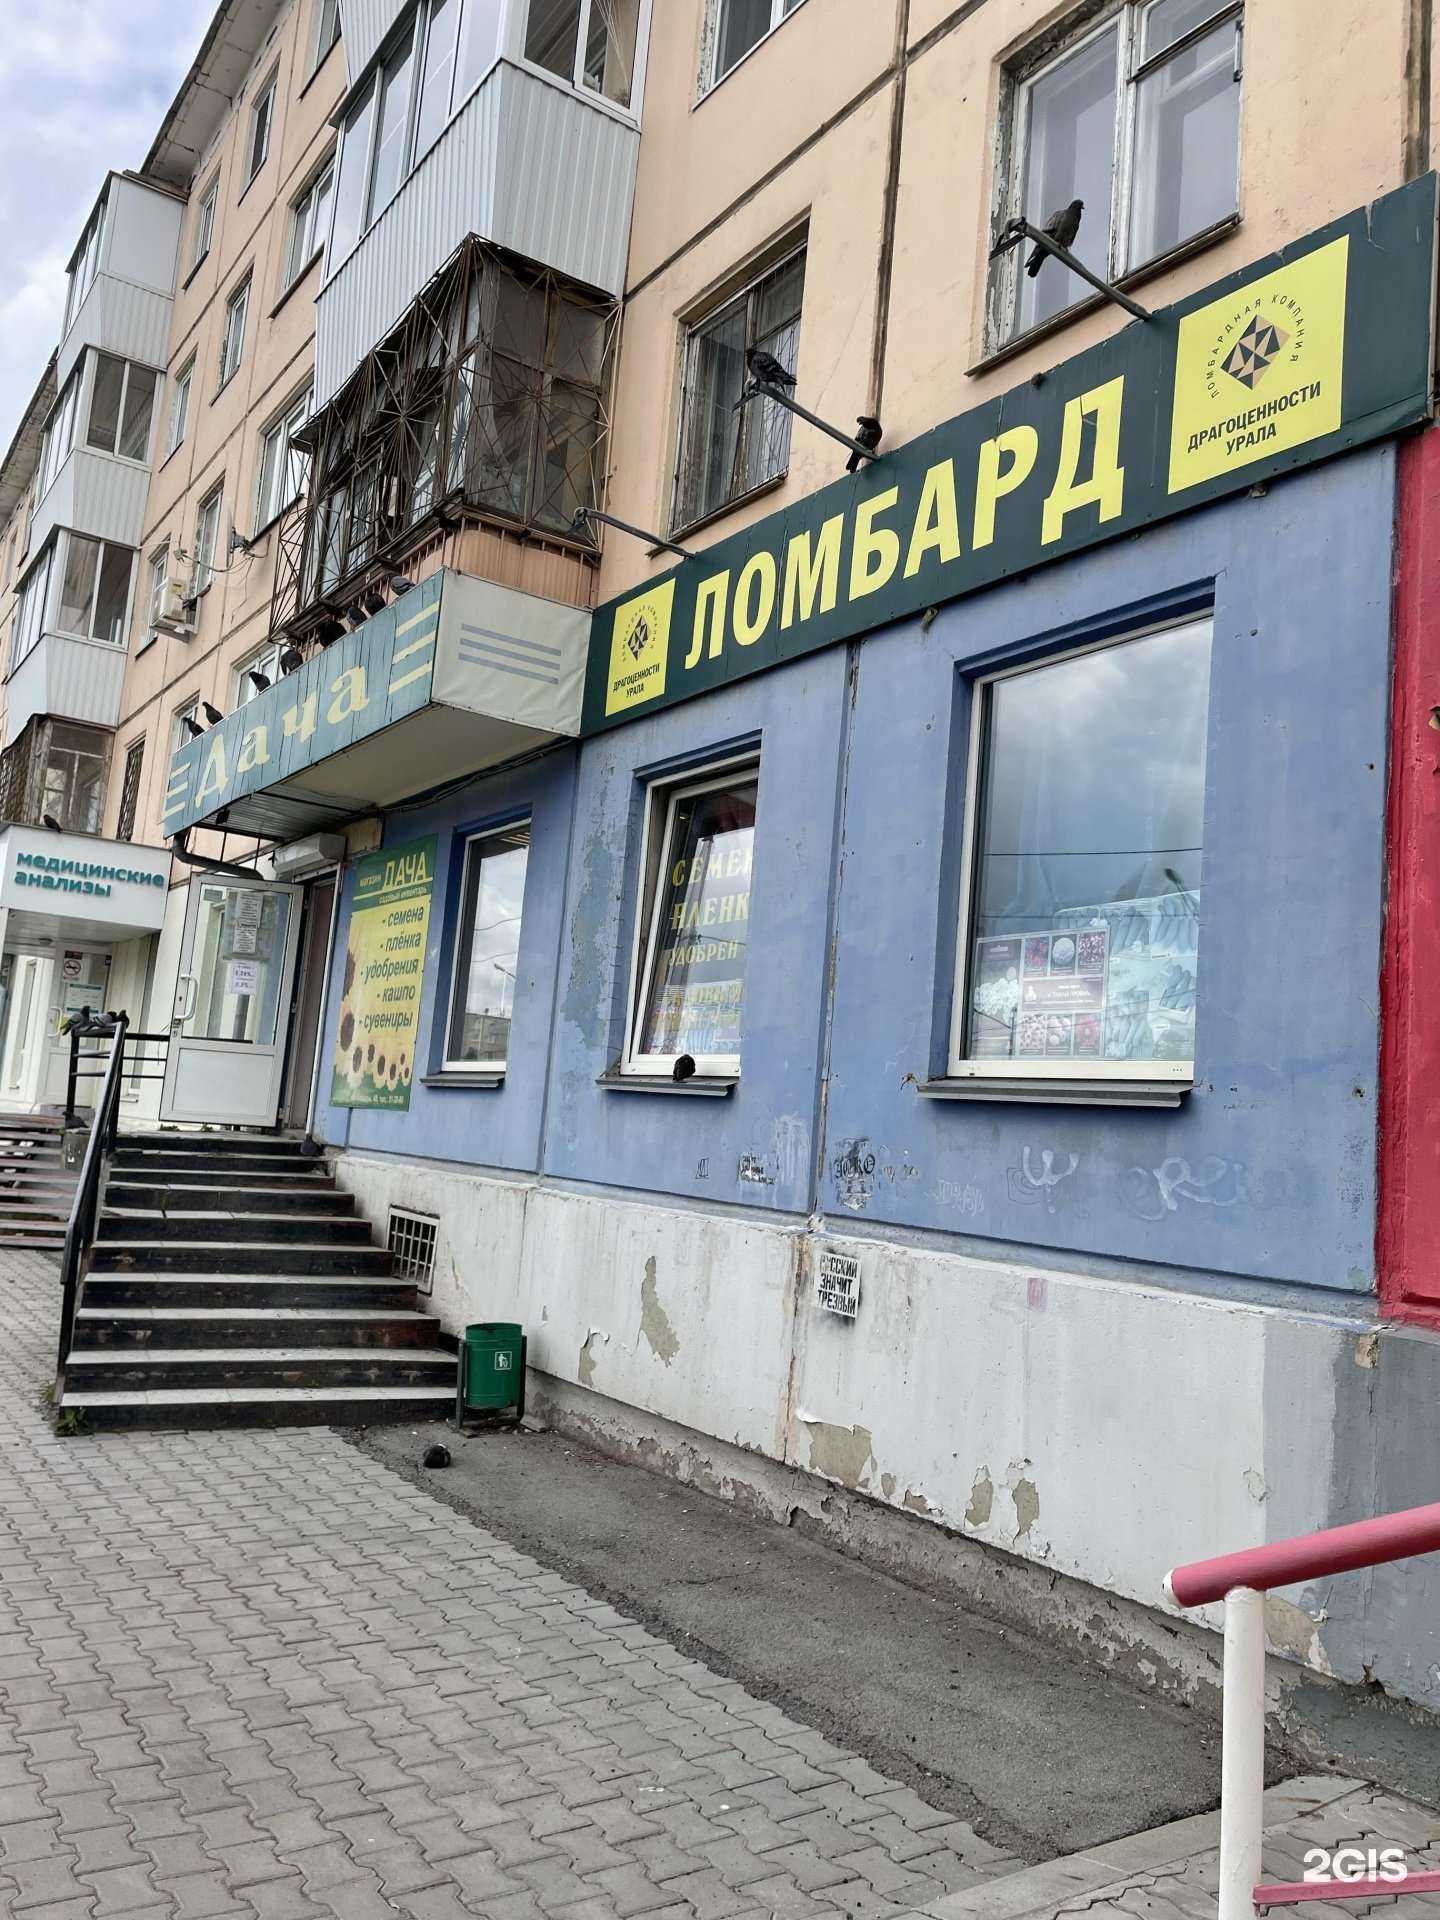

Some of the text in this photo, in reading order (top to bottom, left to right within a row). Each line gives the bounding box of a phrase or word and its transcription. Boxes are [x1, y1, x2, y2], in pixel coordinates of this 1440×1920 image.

[1187, 381, 1321, 453] ДРАГОЦЕННОСТИ
[1226, 422, 1277, 455] УРАЛА
[685, 375, 1124, 669] ЛОМБАРД
[613, 663, 660, 693] ДРАГОЦЕННОСТИ
[626, 683, 645, 698] УРАЛА
[195, 664, 370, 808] Дача
[14, 871, 112, 897] анализы
[16, 853, 165, 889] медицинские
[383, 851, 427, 892] ДАЧА
[388, 906, 424, 927] семена
[385, 931, 421, 952] плёнка
[365, 958, 418, 984] удобрения
[383, 985, 416, 1002] кашпо
[364, 1011, 413, 1033] сувениры
[820, 1273, 853, 1296] ЗНАЧИТ
